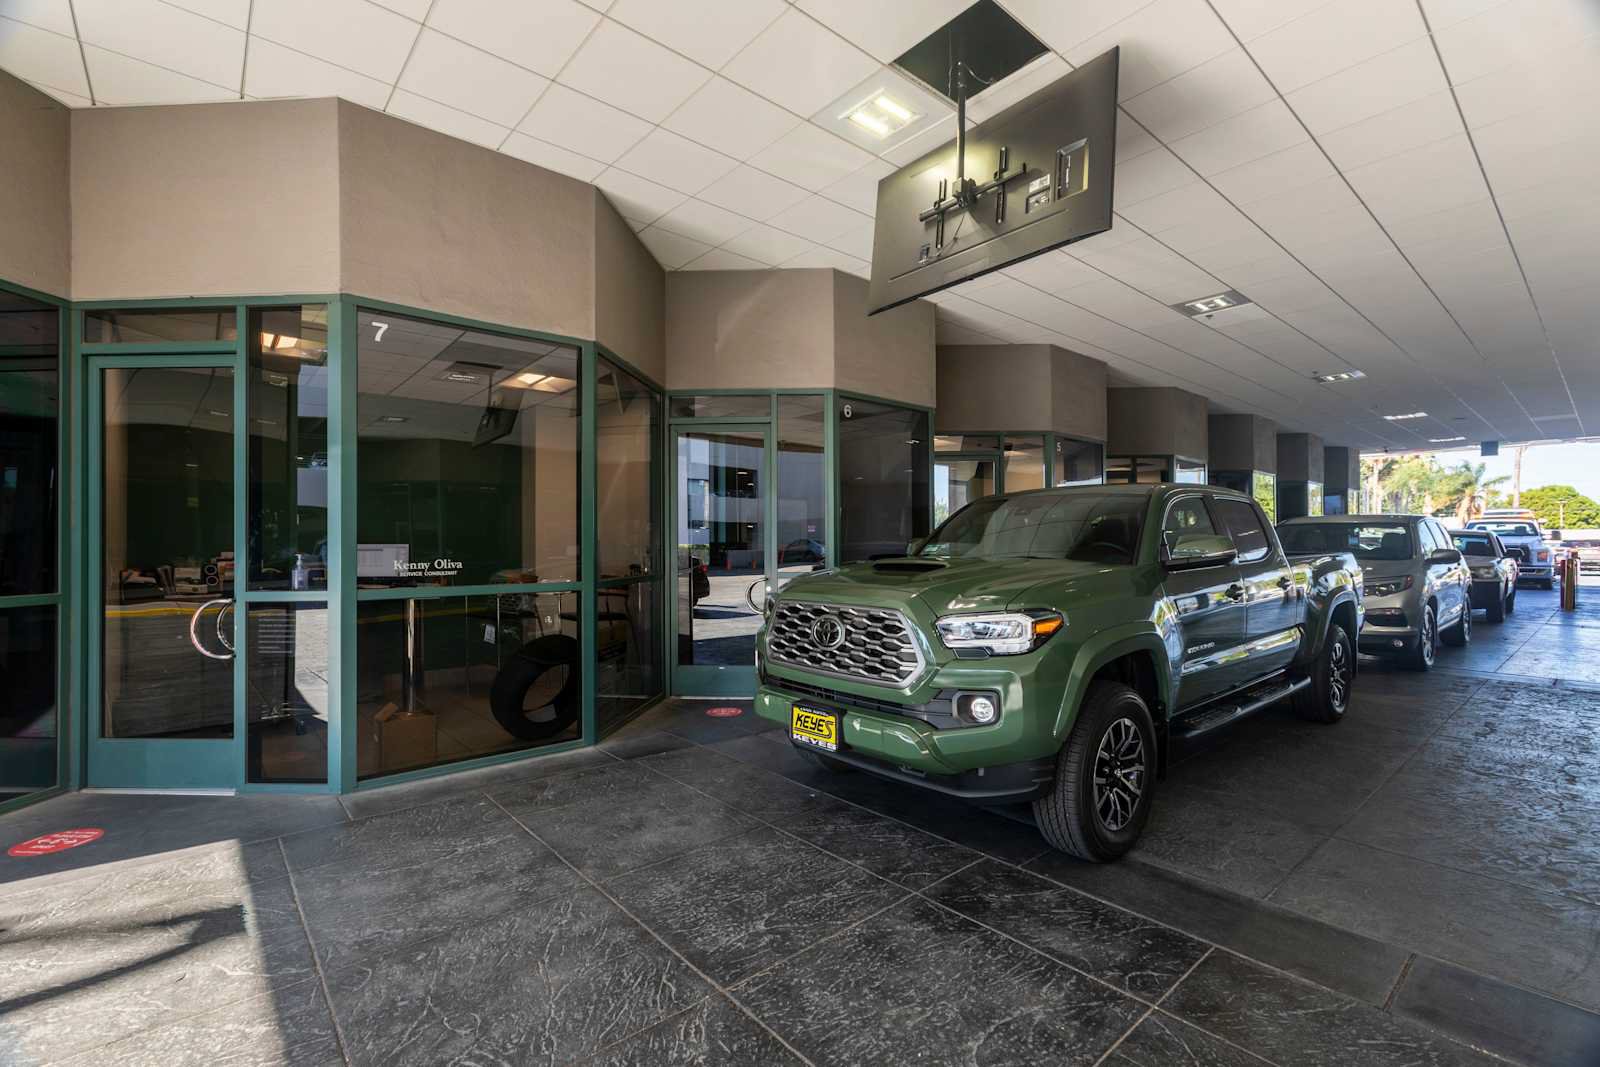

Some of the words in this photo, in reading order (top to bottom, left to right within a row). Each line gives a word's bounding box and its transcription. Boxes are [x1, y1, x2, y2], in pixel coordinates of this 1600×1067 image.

[371, 321, 389, 342] 7
[843, 404, 852, 418] 6
[1056, 441, 1062, 452] 5
[393, 560, 430, 572] Kenny
[434, 558, 463, 569] Oliva
[795, 713, 837, 739] KEYES
[792, 734, 837, 751] KEYES
